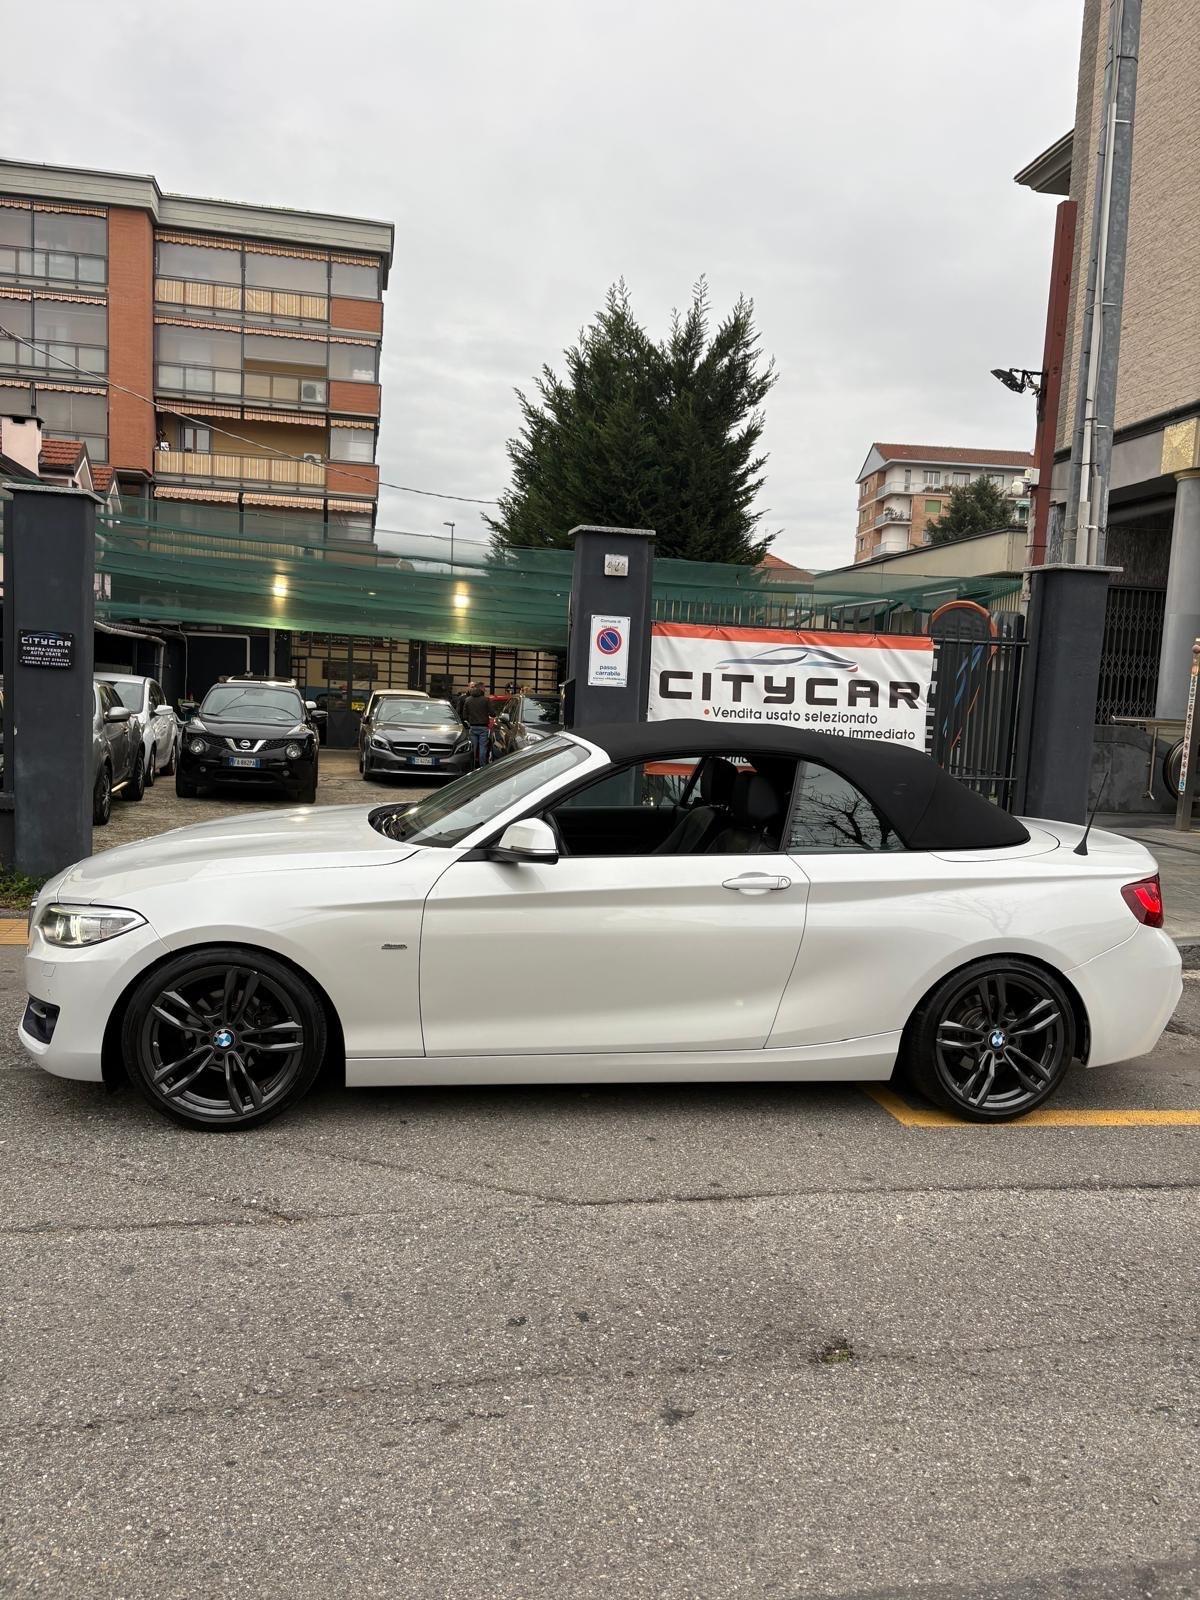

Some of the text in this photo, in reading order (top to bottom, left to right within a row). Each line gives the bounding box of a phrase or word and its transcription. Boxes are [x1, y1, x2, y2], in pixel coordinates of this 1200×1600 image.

[21, 636, 71, 646] CITYCAR
[659, 670, 920, 709] CITYCAR
[712, 706, 878, 724] Vendita usato selezionato
[849, 727, 916, 740] immediato
